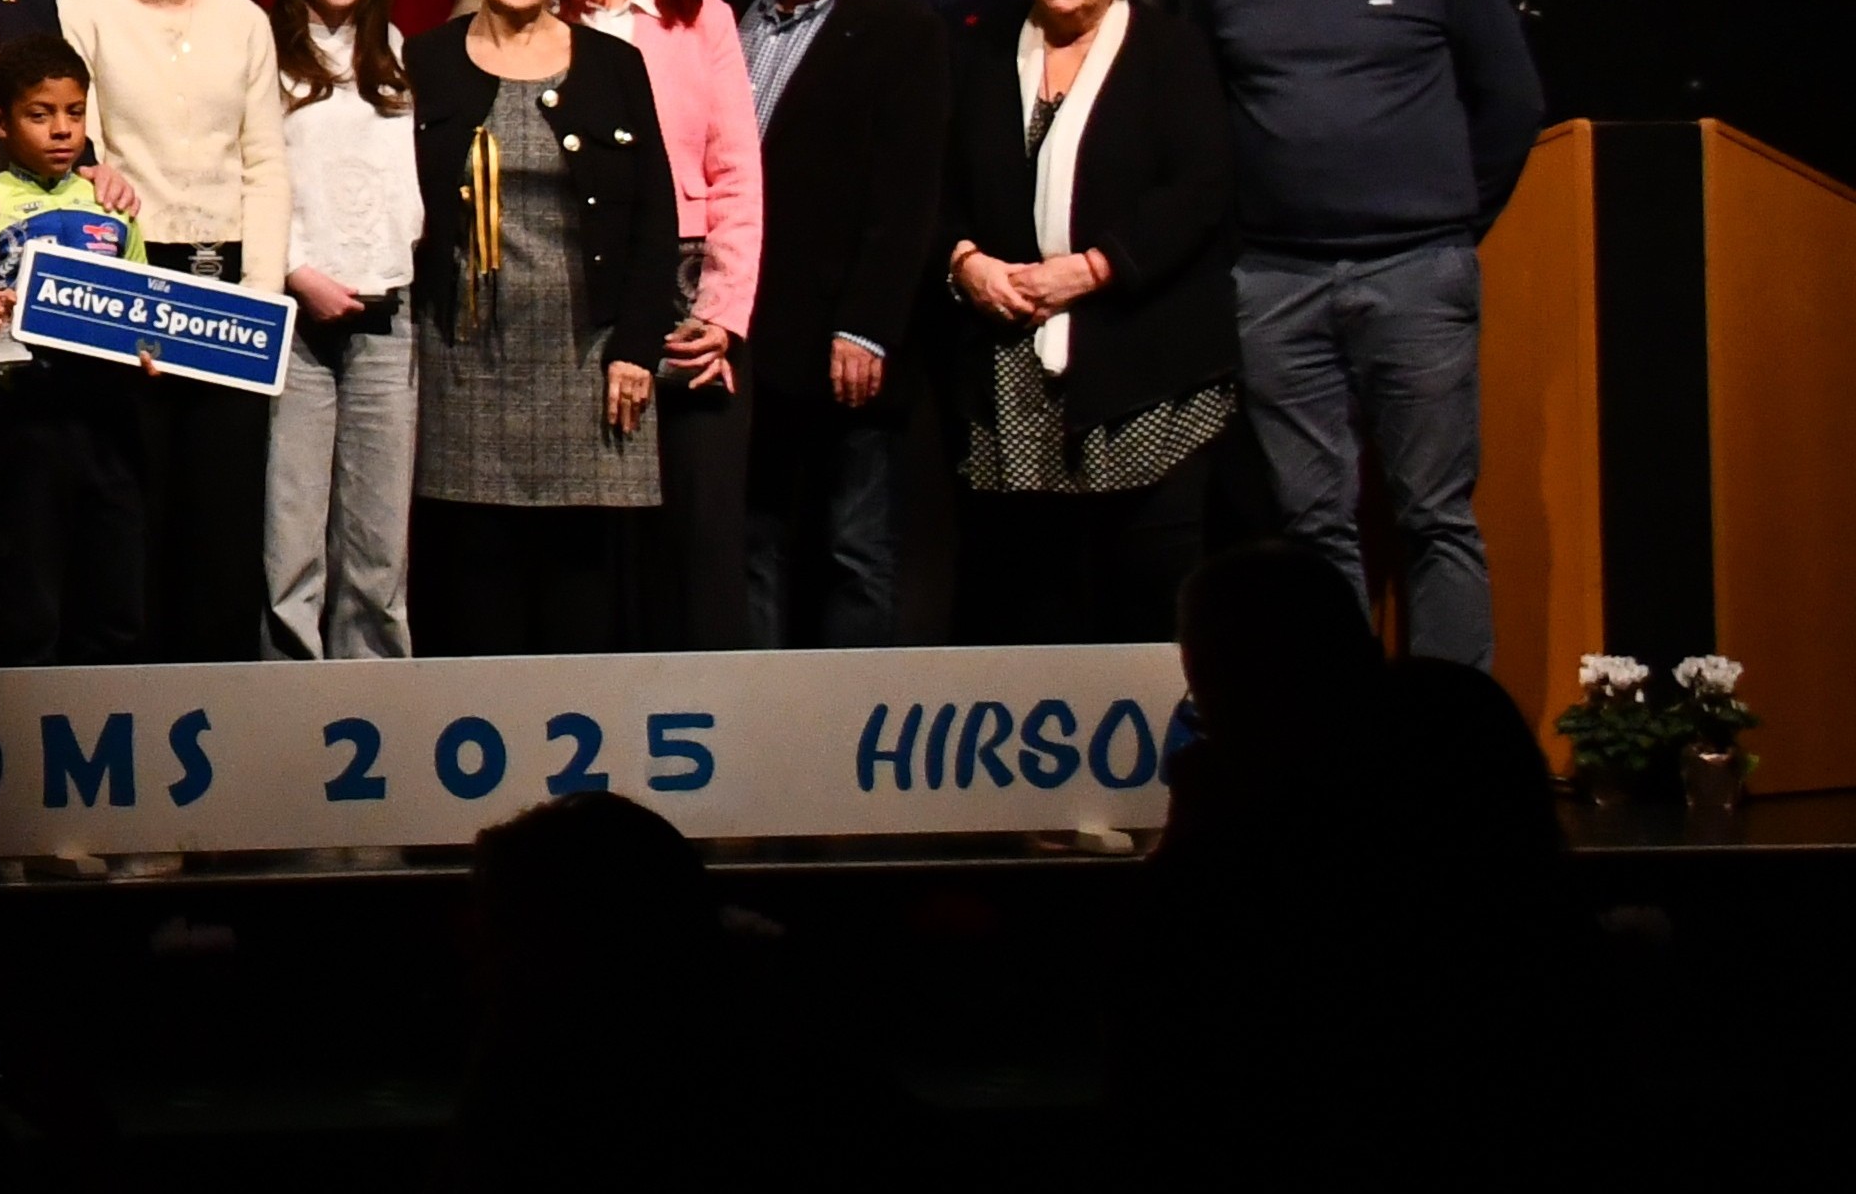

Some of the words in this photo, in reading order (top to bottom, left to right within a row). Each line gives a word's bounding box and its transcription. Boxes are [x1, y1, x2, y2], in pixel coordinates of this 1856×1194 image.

[36, 277, 124, 318] Active
[128, 297, 148, 324] &
[152, 303, 269, 349] Sportive
[147, 277, 171, 294] Ville
[322, 710, 717, 802] 2025
